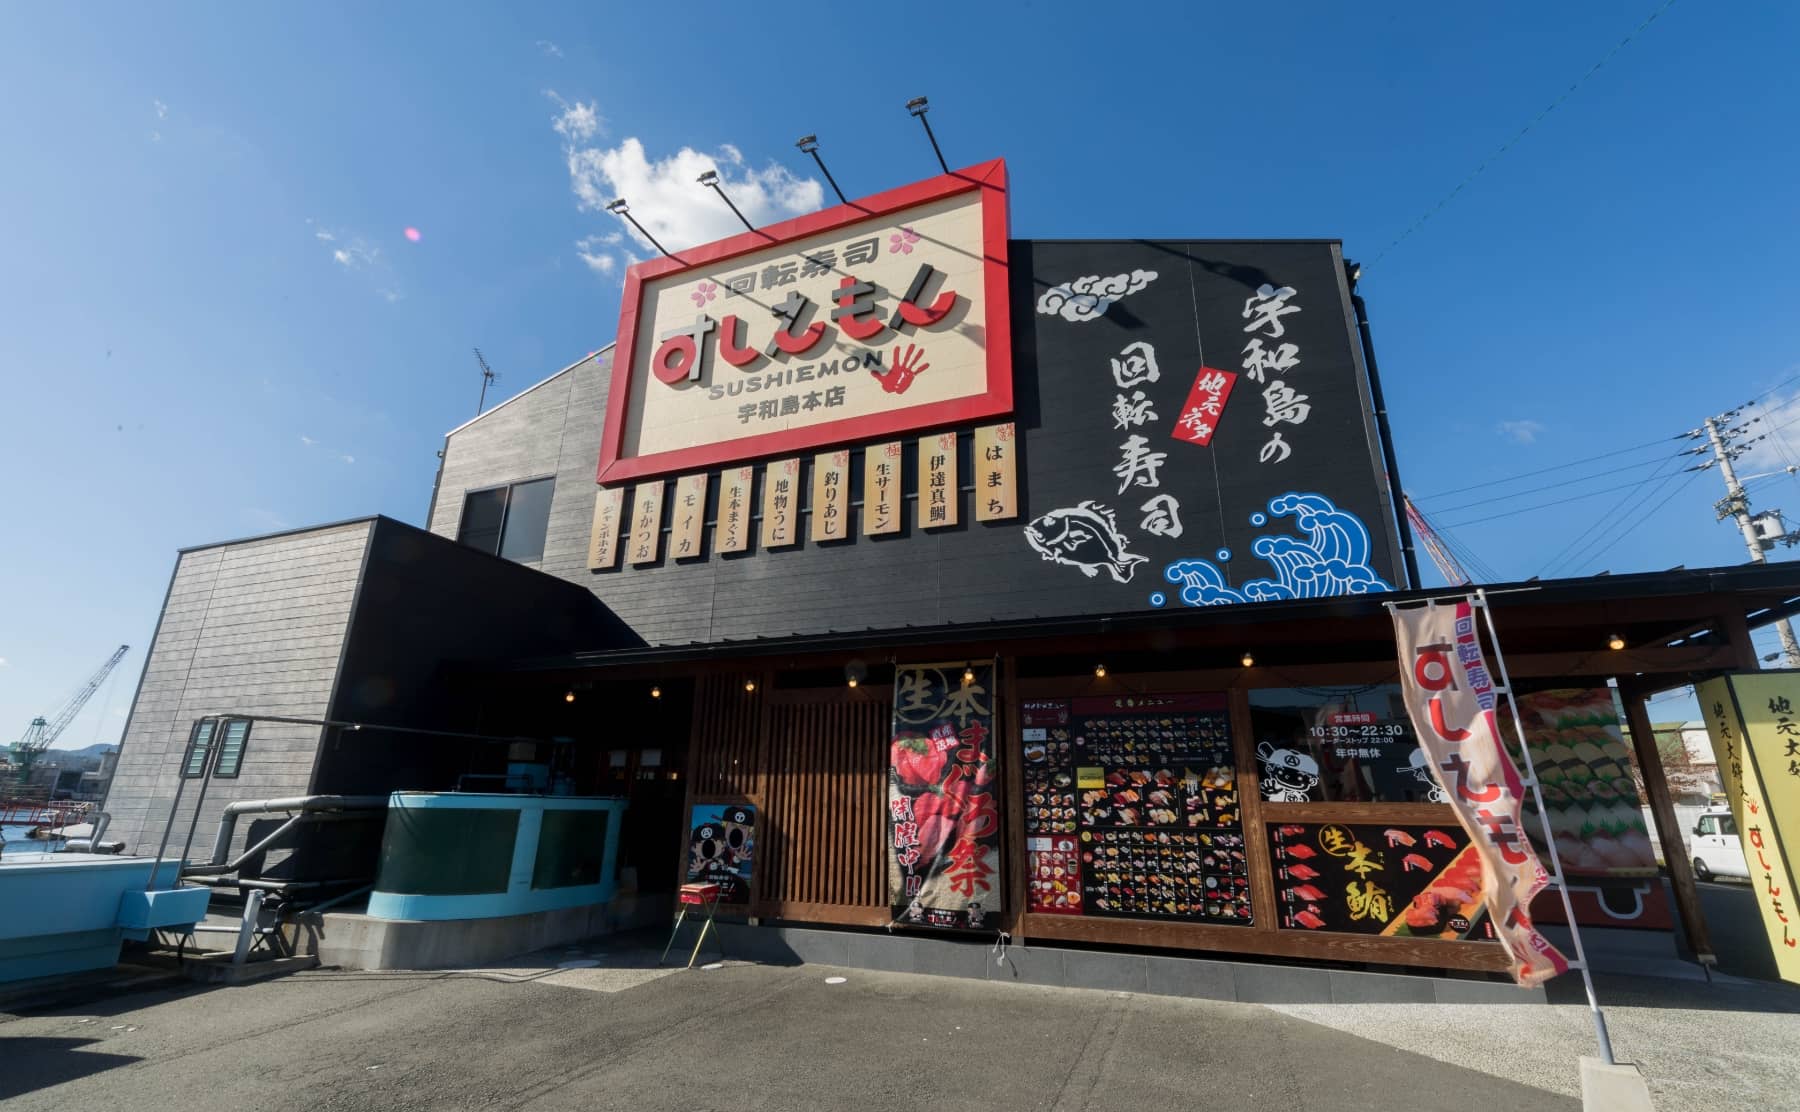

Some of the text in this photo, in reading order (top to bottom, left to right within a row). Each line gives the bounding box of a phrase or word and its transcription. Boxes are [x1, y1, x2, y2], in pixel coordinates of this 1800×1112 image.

[725, 236, 880, 299] 回転寿司
[652, 262, 957, 385] すしえもん
[707, 350, 885, 400] SUSHIEMON
[737, 385, 846, 424] 宇和島本店
[1241, 283, 1312, 464] 宇和島の
[1109, 341, 1184, 538] 回転寿司
[772, 478, 790, 541] 地物うに
[823, 471, 839, 535] 釣りあじ
[874, 463, 891, 529] 生サーモン
[929, 454, 947, 522] 伊達真鯛
[985, 445, 1004, 515] はまち
[636, 500, 654, 558] 生かつお
[679, 494, 696, 552] モイカ
[720, 485, 743, 548] 生本まぐろ
[1455, 617, 1495, 711] 回転寿司
[1335, 748, 1382, 759] 年中無休
[1370, 736, 1394, 744] 22:00
